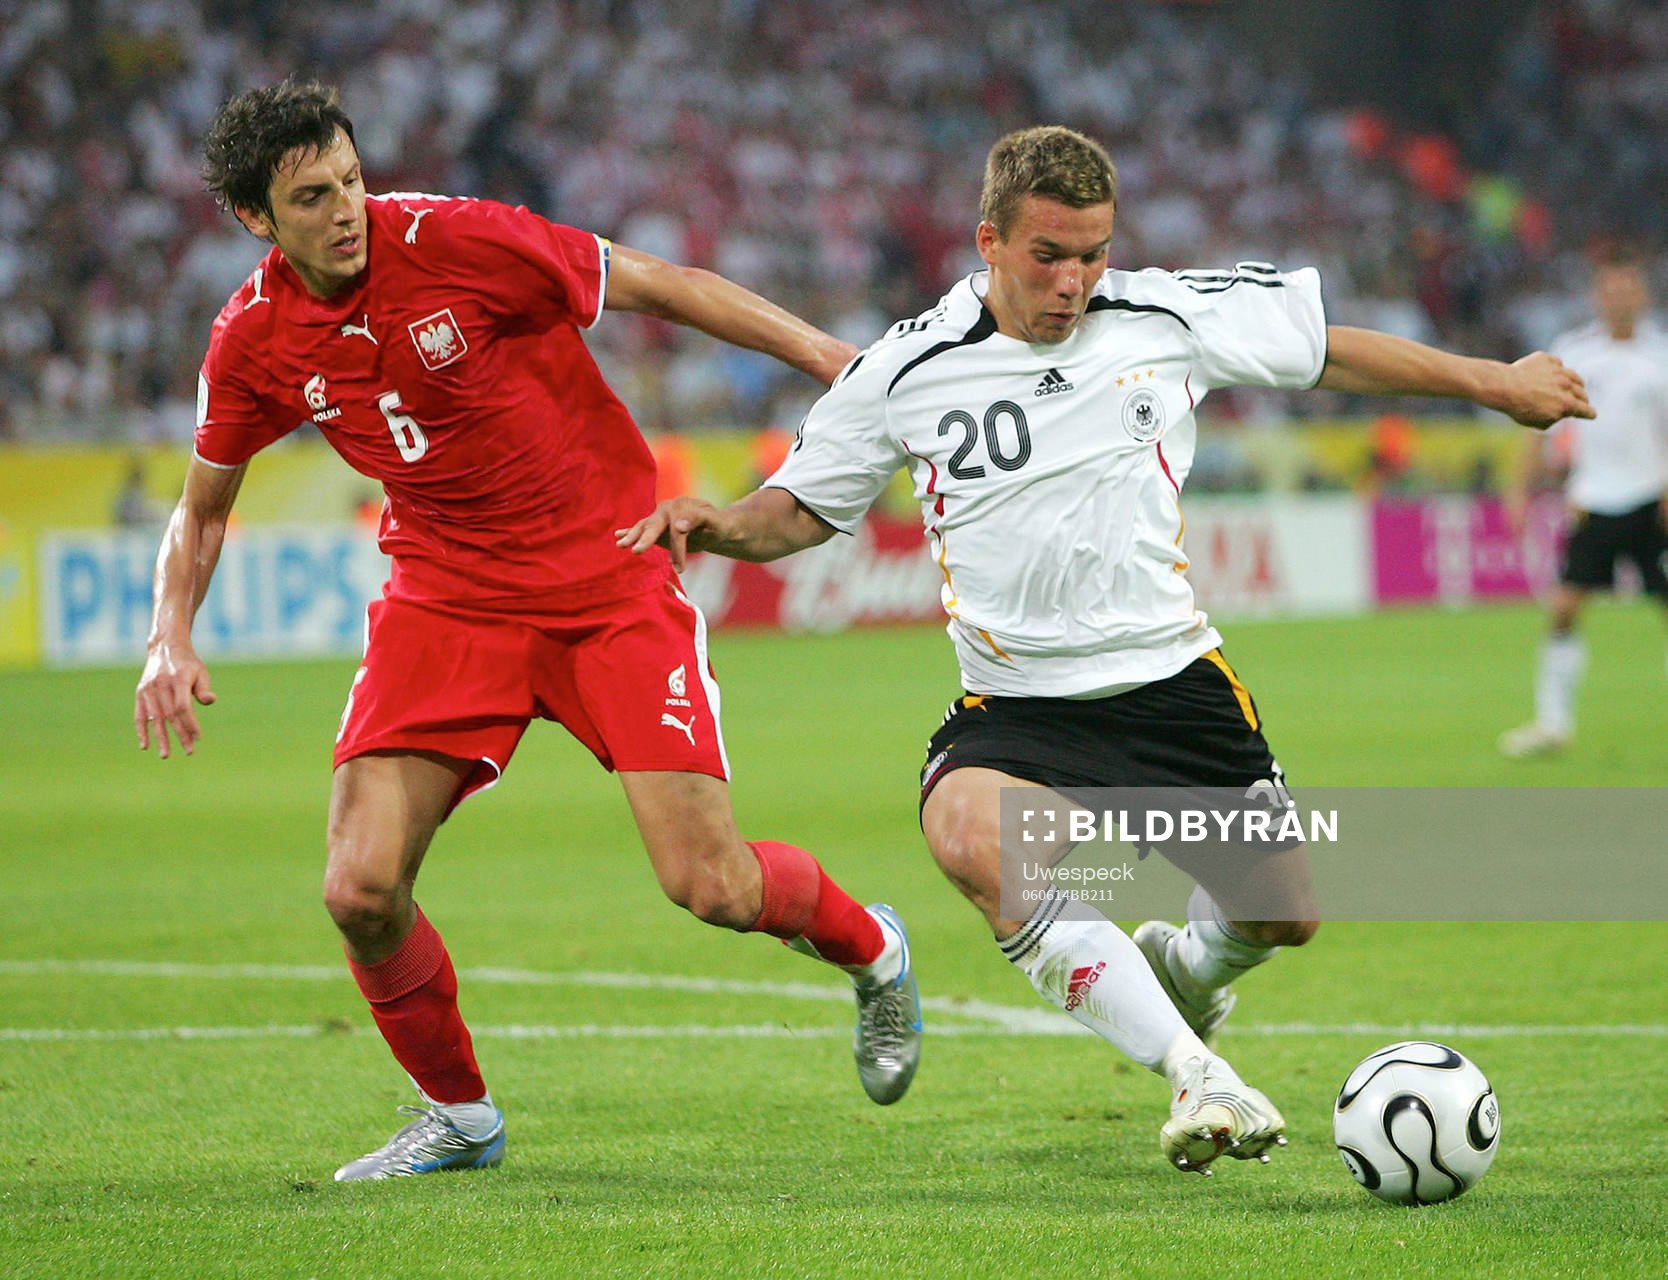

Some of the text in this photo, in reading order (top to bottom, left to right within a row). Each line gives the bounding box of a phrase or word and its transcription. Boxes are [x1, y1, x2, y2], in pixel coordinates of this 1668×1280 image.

[313, 407, 342, 423] POLSKA
[1034, 382, 1074, 397] adidas
[378, 390, 429, 463] 6
[937, 400, 1032, 480] 20
[59, 537, 364, 641] PHLIPS
